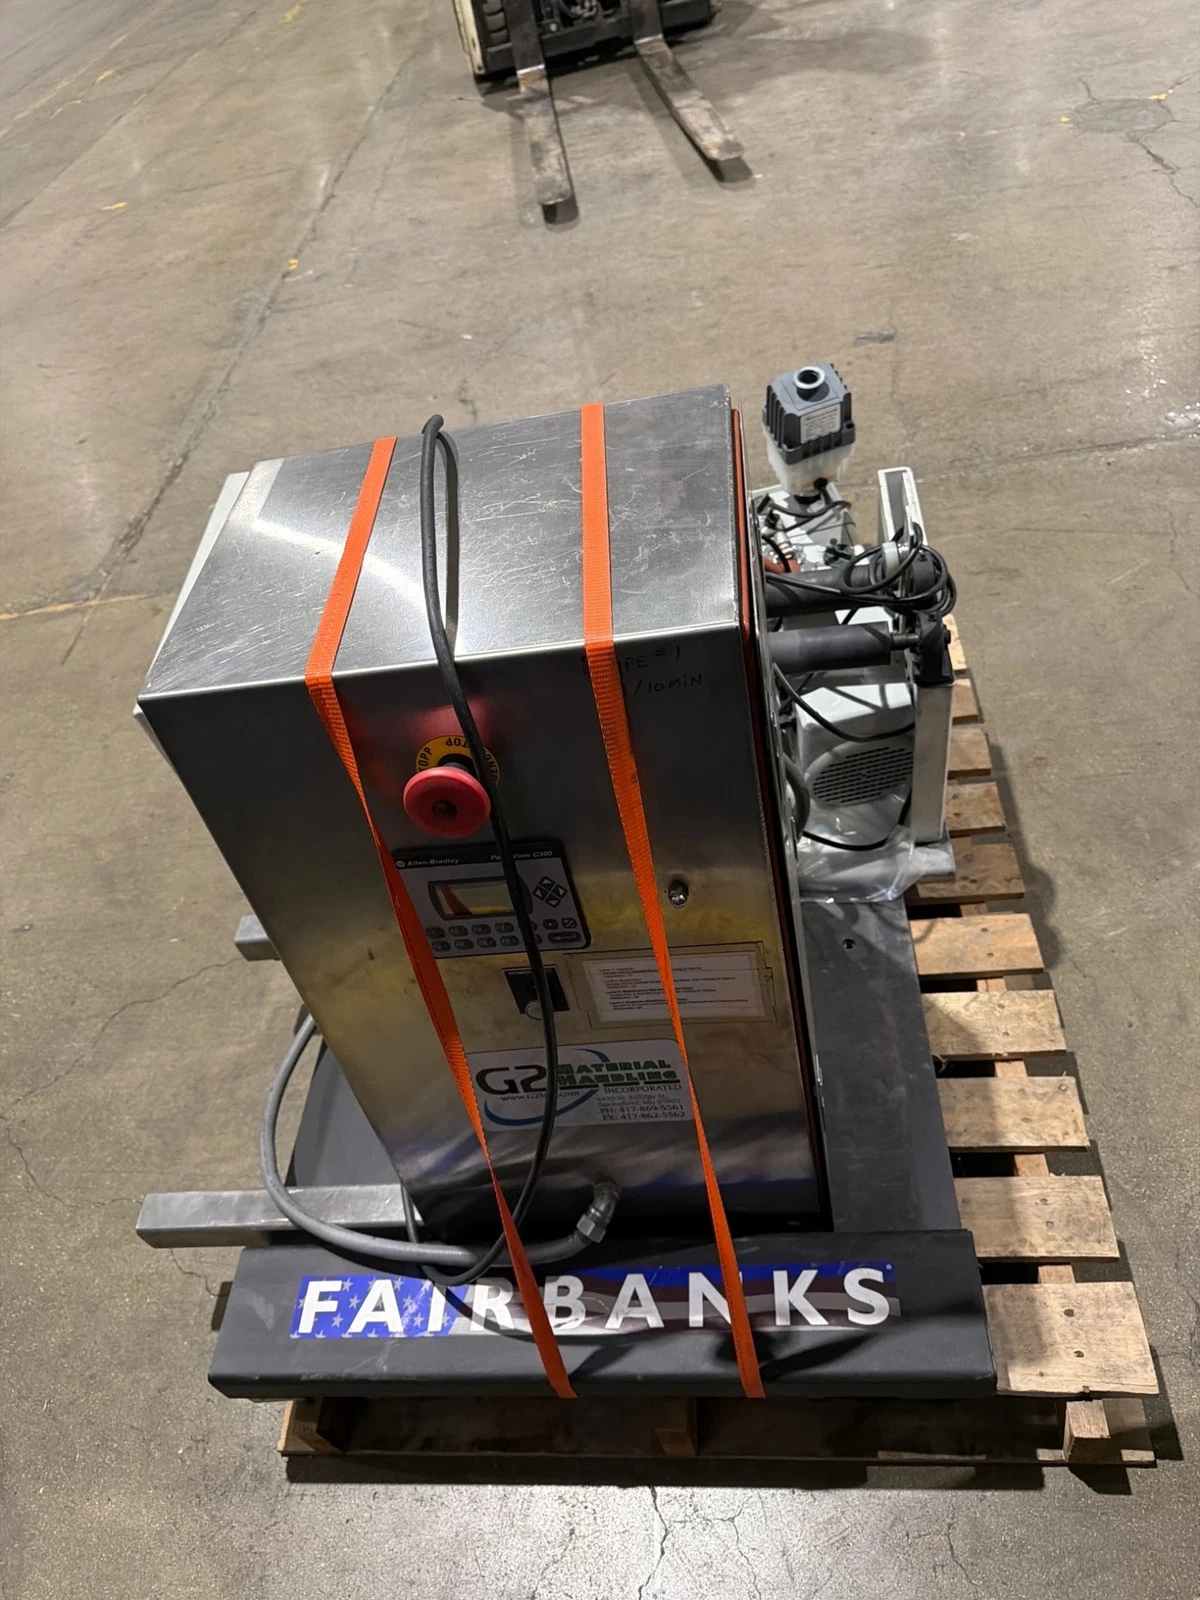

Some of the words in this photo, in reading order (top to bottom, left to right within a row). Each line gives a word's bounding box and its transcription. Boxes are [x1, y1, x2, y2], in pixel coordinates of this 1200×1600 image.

[446, 737, 469, 749] TOP
[532, 850, 553, 858] C300
[407, 857, 460, 867] Allen-Bradley
[475, 1064, 547, 1095] G2
[604, 1084, 682, 1094] INCORPORATED
[298, 1267, 892, 1335] FAIRBANKS
